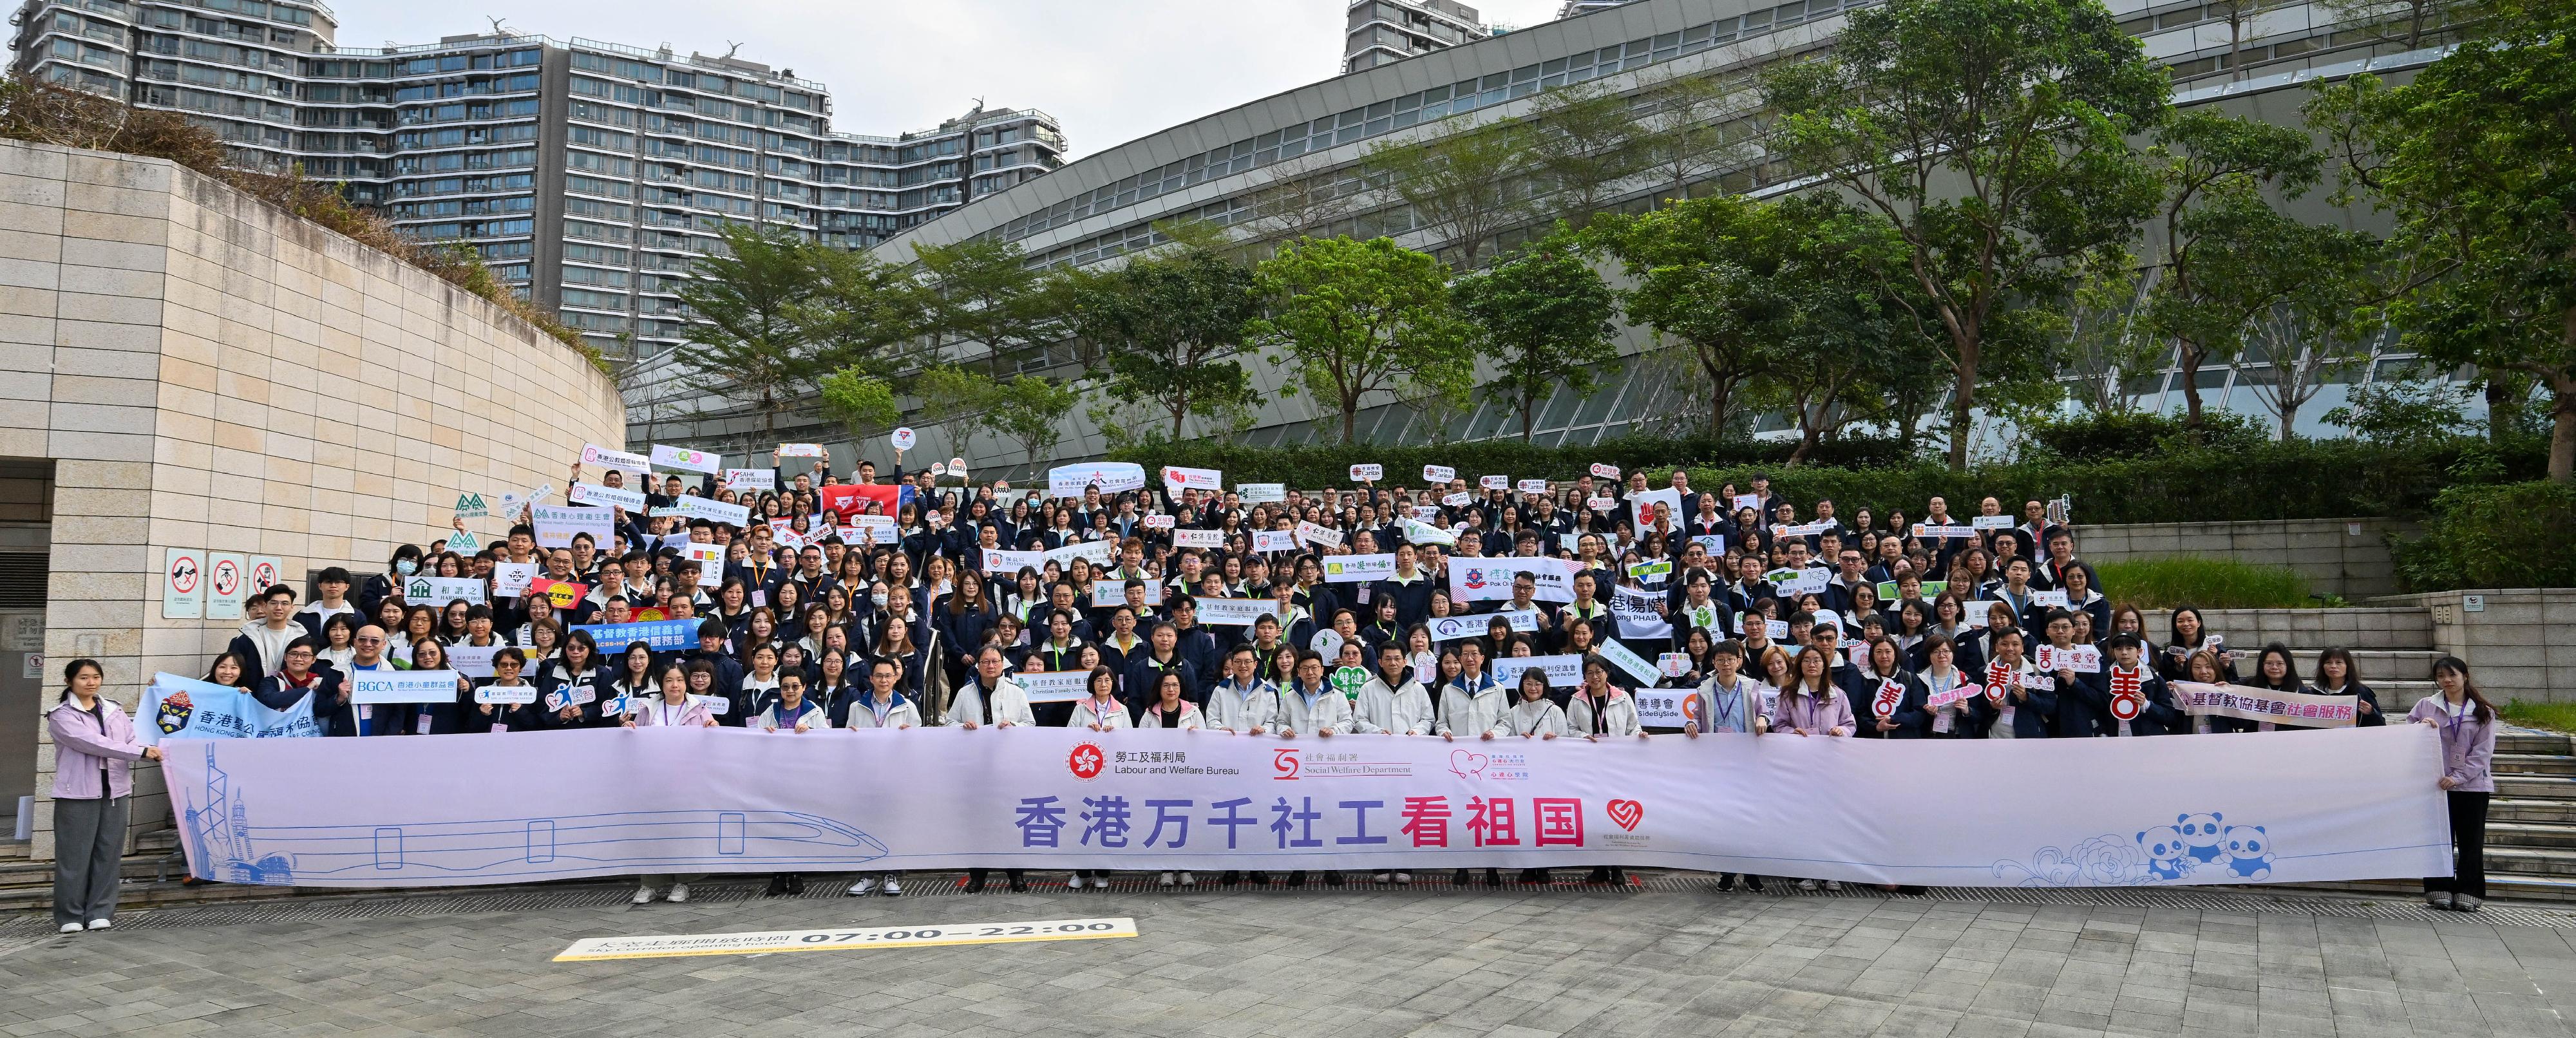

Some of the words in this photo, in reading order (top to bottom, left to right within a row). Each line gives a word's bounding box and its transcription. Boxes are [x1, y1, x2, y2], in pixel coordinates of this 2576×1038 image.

[857, 500, 884, 508] YMA
[1191, 533, 1219, 541] 仁濟醫院
[1312, 527, 1338, 542] 仁濟醫院
[1636, 565, 1665, 575] YWCA
[1535, 573, 1562, 581] 社會服務
[1889, 583, 1942, 596] YCA
[1206, 604, 1274, 612] 基督教家庭服務中心
[592, 625, 684, 639] 基督教香港信義會
[2057, 652, 2096, 664] 仁愛堂
[1510, 664, 1577, 674] 香港福利促進會
[1032, 677, 1088, 687] 基督教家庭服務
[1339, 672, 1364, 686] 聾健
[2025, 675, 2054, 686] 仁愛堂
[357, 681, 393, 692] BGCA
[571, 688, 593, 700] 懷智
[1638, 698, 1674, 710] 善導會
[2192, 692, 2353, 720] 基督教協基會社會服務
[195, 725, 214, 733] HONG
[301, 728, 320, 737] COUNC
[1115, 751, 1186, 763] 勞工及福利局
[1305, 753, 1358, 762] 社會福利署
[1115, 765, 1148, 774] Labour
[1150, 766, 1166, 774] and
[1170, 766, 1204, 775] Welfare
[1207, 767, 1239, 775] Bureau
[1305, 766, 1329, 774] Social
[1330, 766, 1361, 774] Welfare
[1363, 766, 1411, 776] Department
[1015, 795, 1584, 849] 香港万千社工看祖国
[592, 936, 791, 948] 天空走廊開放時間
